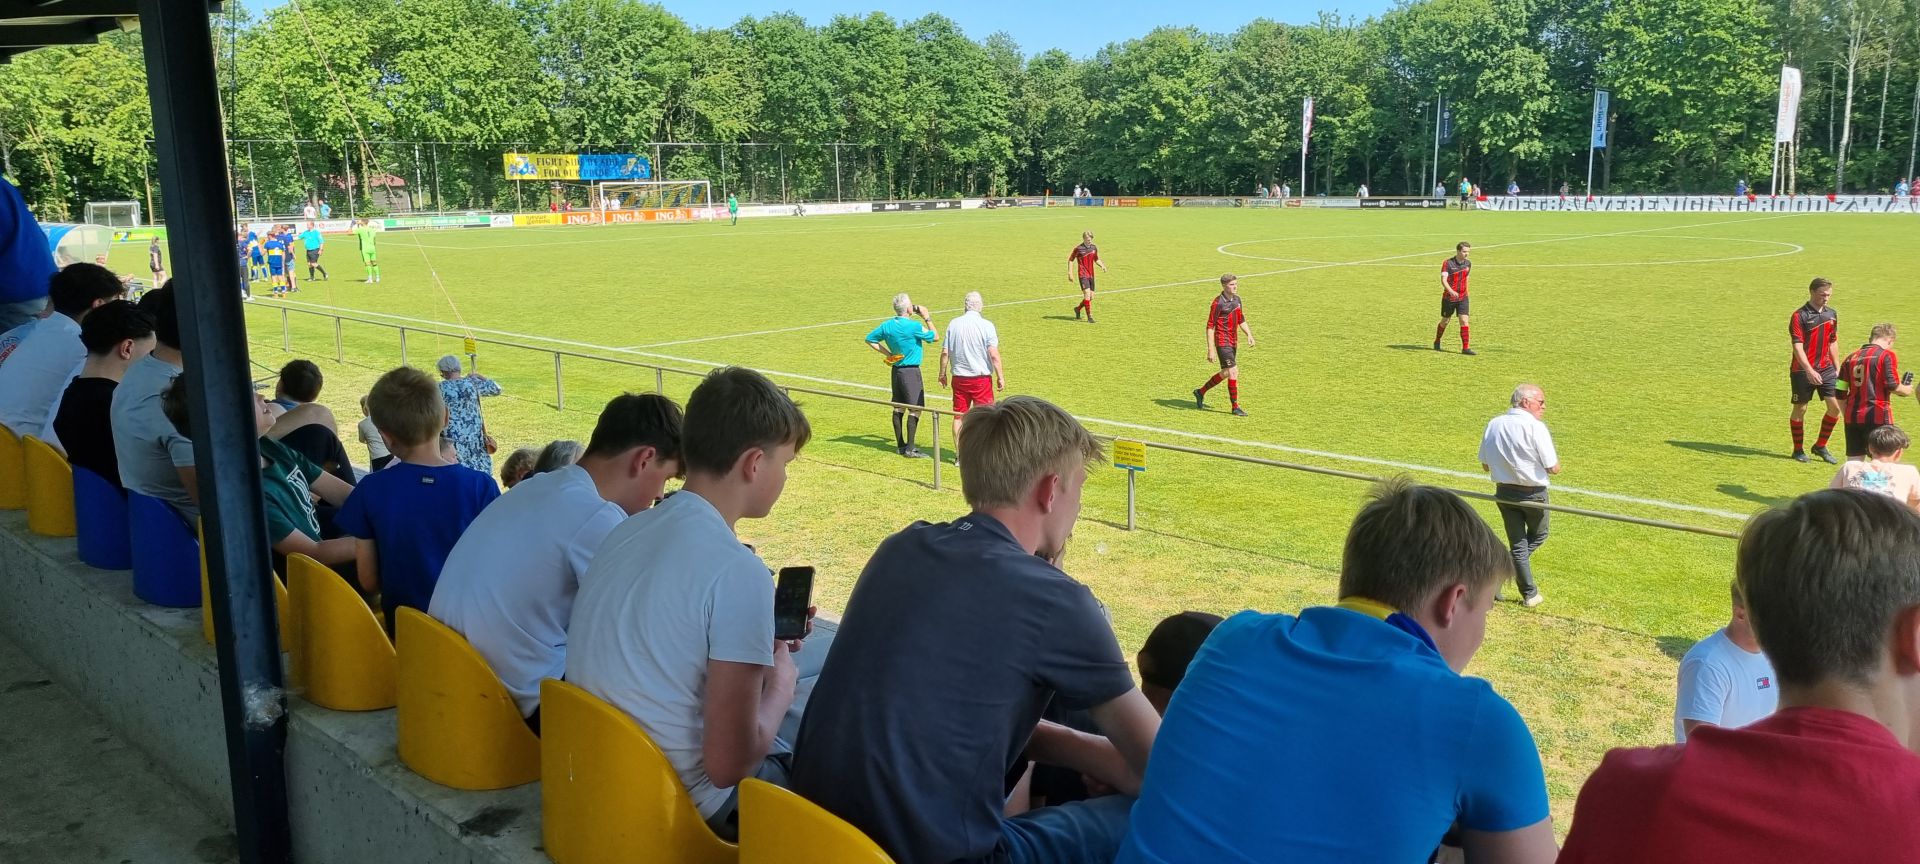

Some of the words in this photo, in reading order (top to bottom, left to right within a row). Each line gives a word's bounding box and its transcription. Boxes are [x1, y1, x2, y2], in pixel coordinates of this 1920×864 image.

[536, 157, 563, 166] FIGHT
[543, 168, 561, 177] FOR
[567, 214, 588, 224] ING
[612, 213, 632, 223] ING
[655, 211, 674, 221] ING
[1853, 363, 1867, 387] 9
